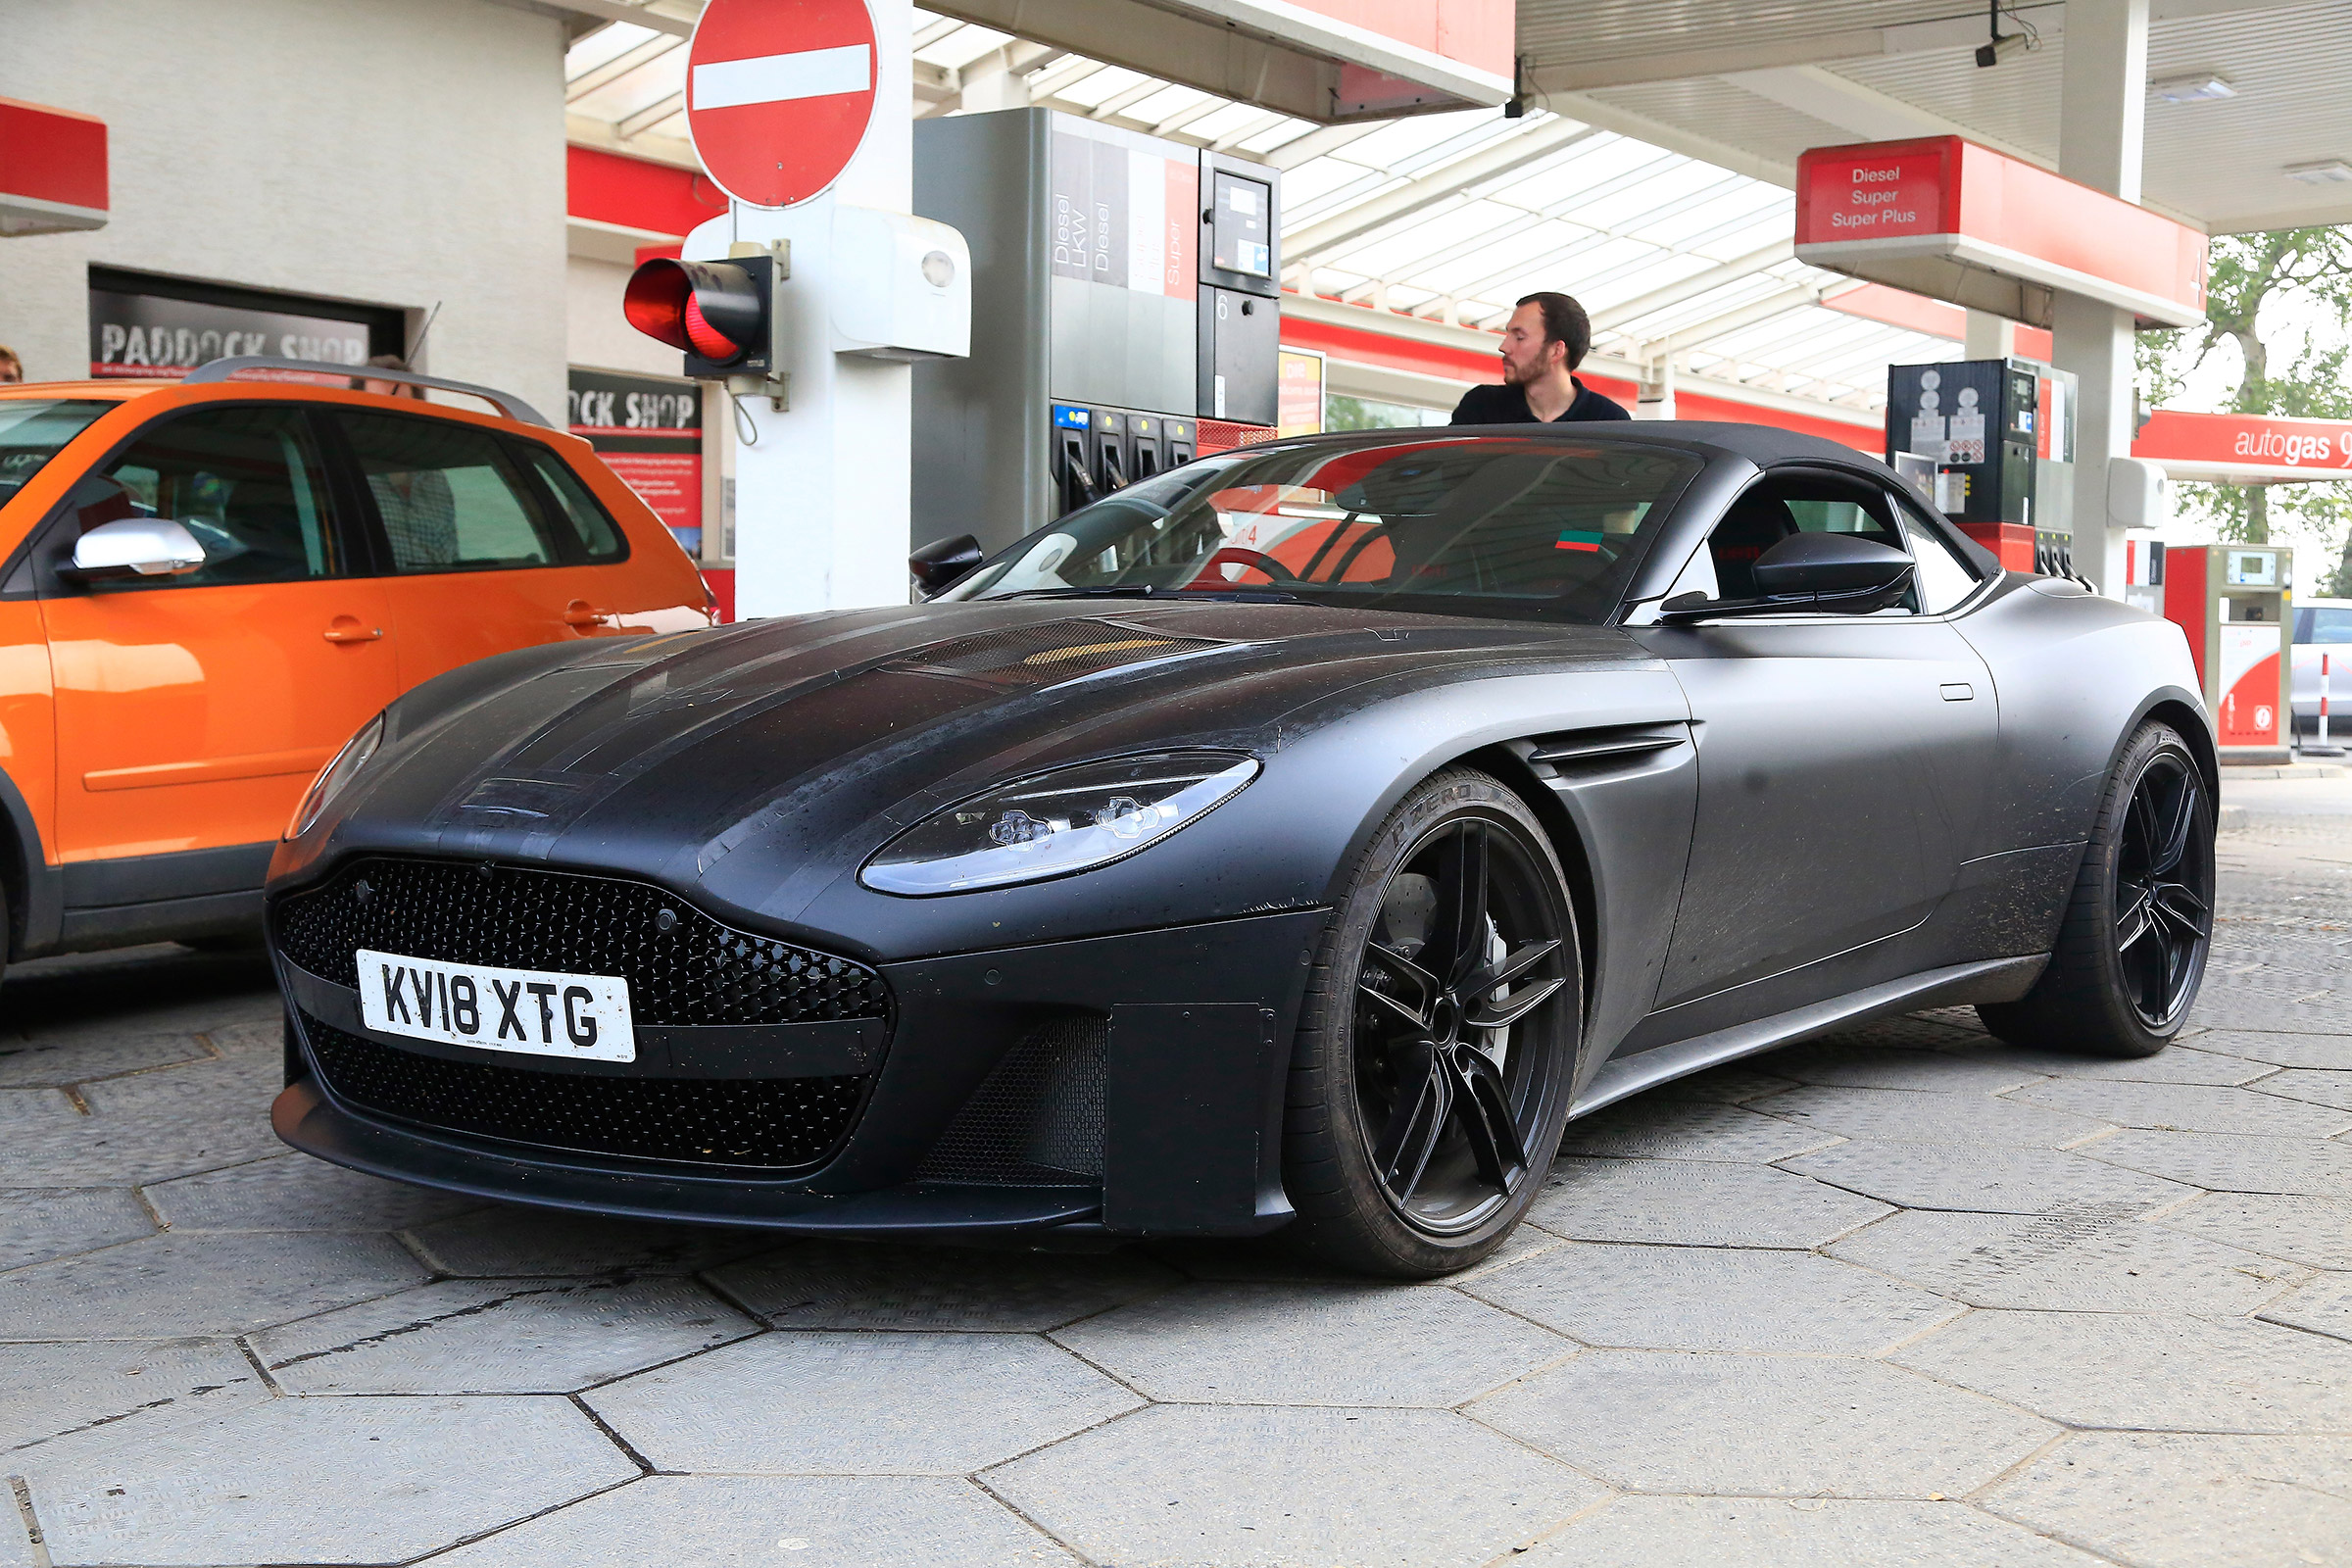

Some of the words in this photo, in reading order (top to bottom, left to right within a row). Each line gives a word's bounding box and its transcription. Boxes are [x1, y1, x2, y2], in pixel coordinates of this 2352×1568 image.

[1851, 166, 1900, 183] Diesel
[1851, 189, 1899, 206] Super
[1054, 193, 1069, 265] Diesel
[1072, 209, 1087, 268] LKW
[1095, 202, 1109, 271] Diesel
[1832, 212, 1879, 228] Super
[1882, 209, 1917, 223] Plus
[1167, 219, 1183, 286] Super
[1218, 295, 1228, 320] 6
[101, 323, 268, 367] PADDOCK
[279, 333, 368, 366] SHOP
[625, 392, 695, 428] SHOP
[2234, 427, 2330, 466] autogas
[1408, 783, 1472, 823] ZERO
[382, 963, 480, 1035] KV18
[492, 979, 598, 1047] XTG
